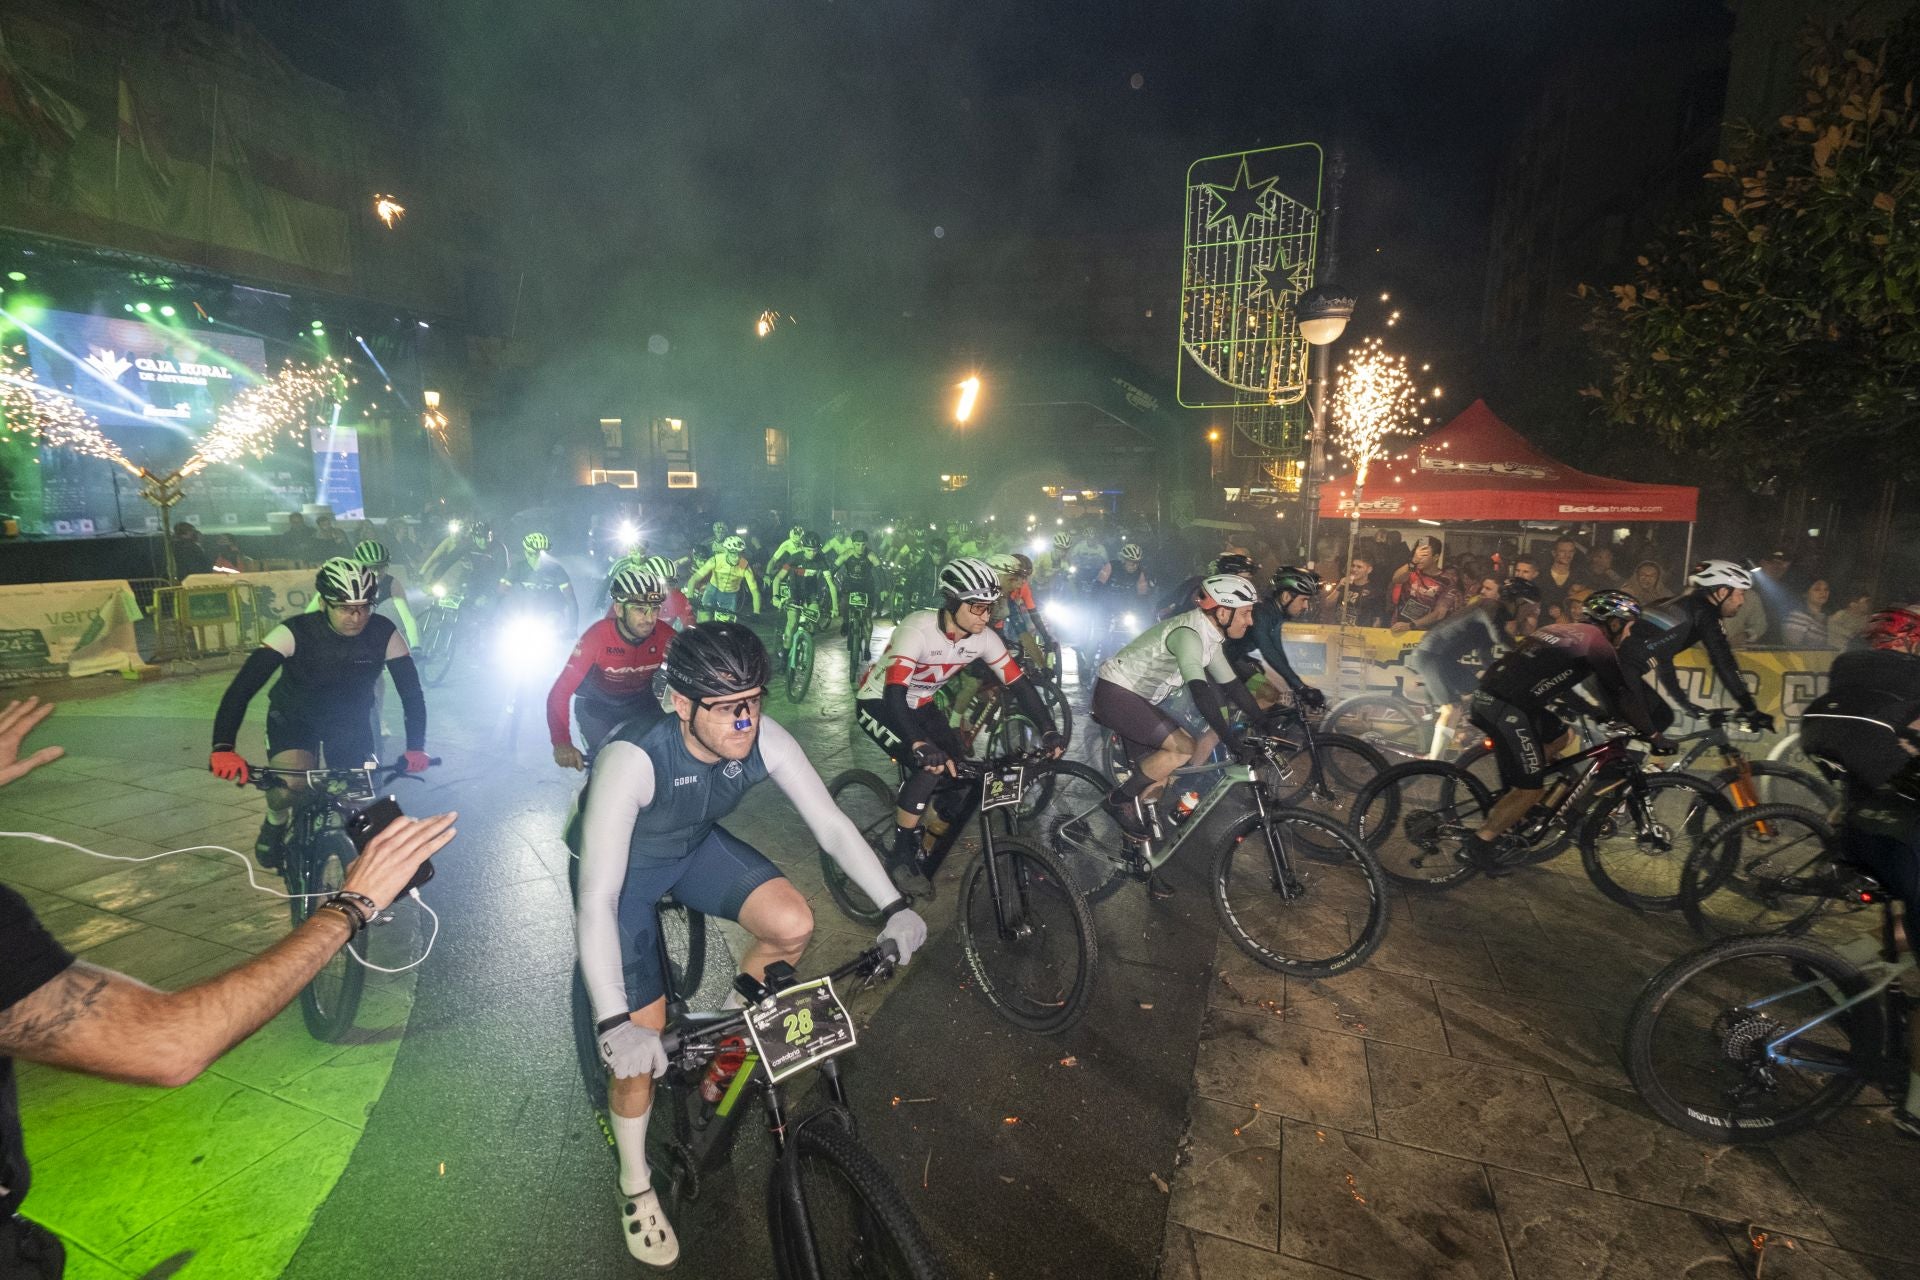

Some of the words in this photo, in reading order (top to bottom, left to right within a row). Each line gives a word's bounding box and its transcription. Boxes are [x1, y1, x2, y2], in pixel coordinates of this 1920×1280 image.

[135, 358, 178, 374] CAJA
[180, 363, 233, 379] RURAL
[1533, 668, 1574, 697] MONTEJO
[858, 709, 902, 748] TNT
[1515, 727, 1541, 775] LASTRA
[674, 776, 698, 787] GOBIK
[783, 1008, 814, 1043] 28
